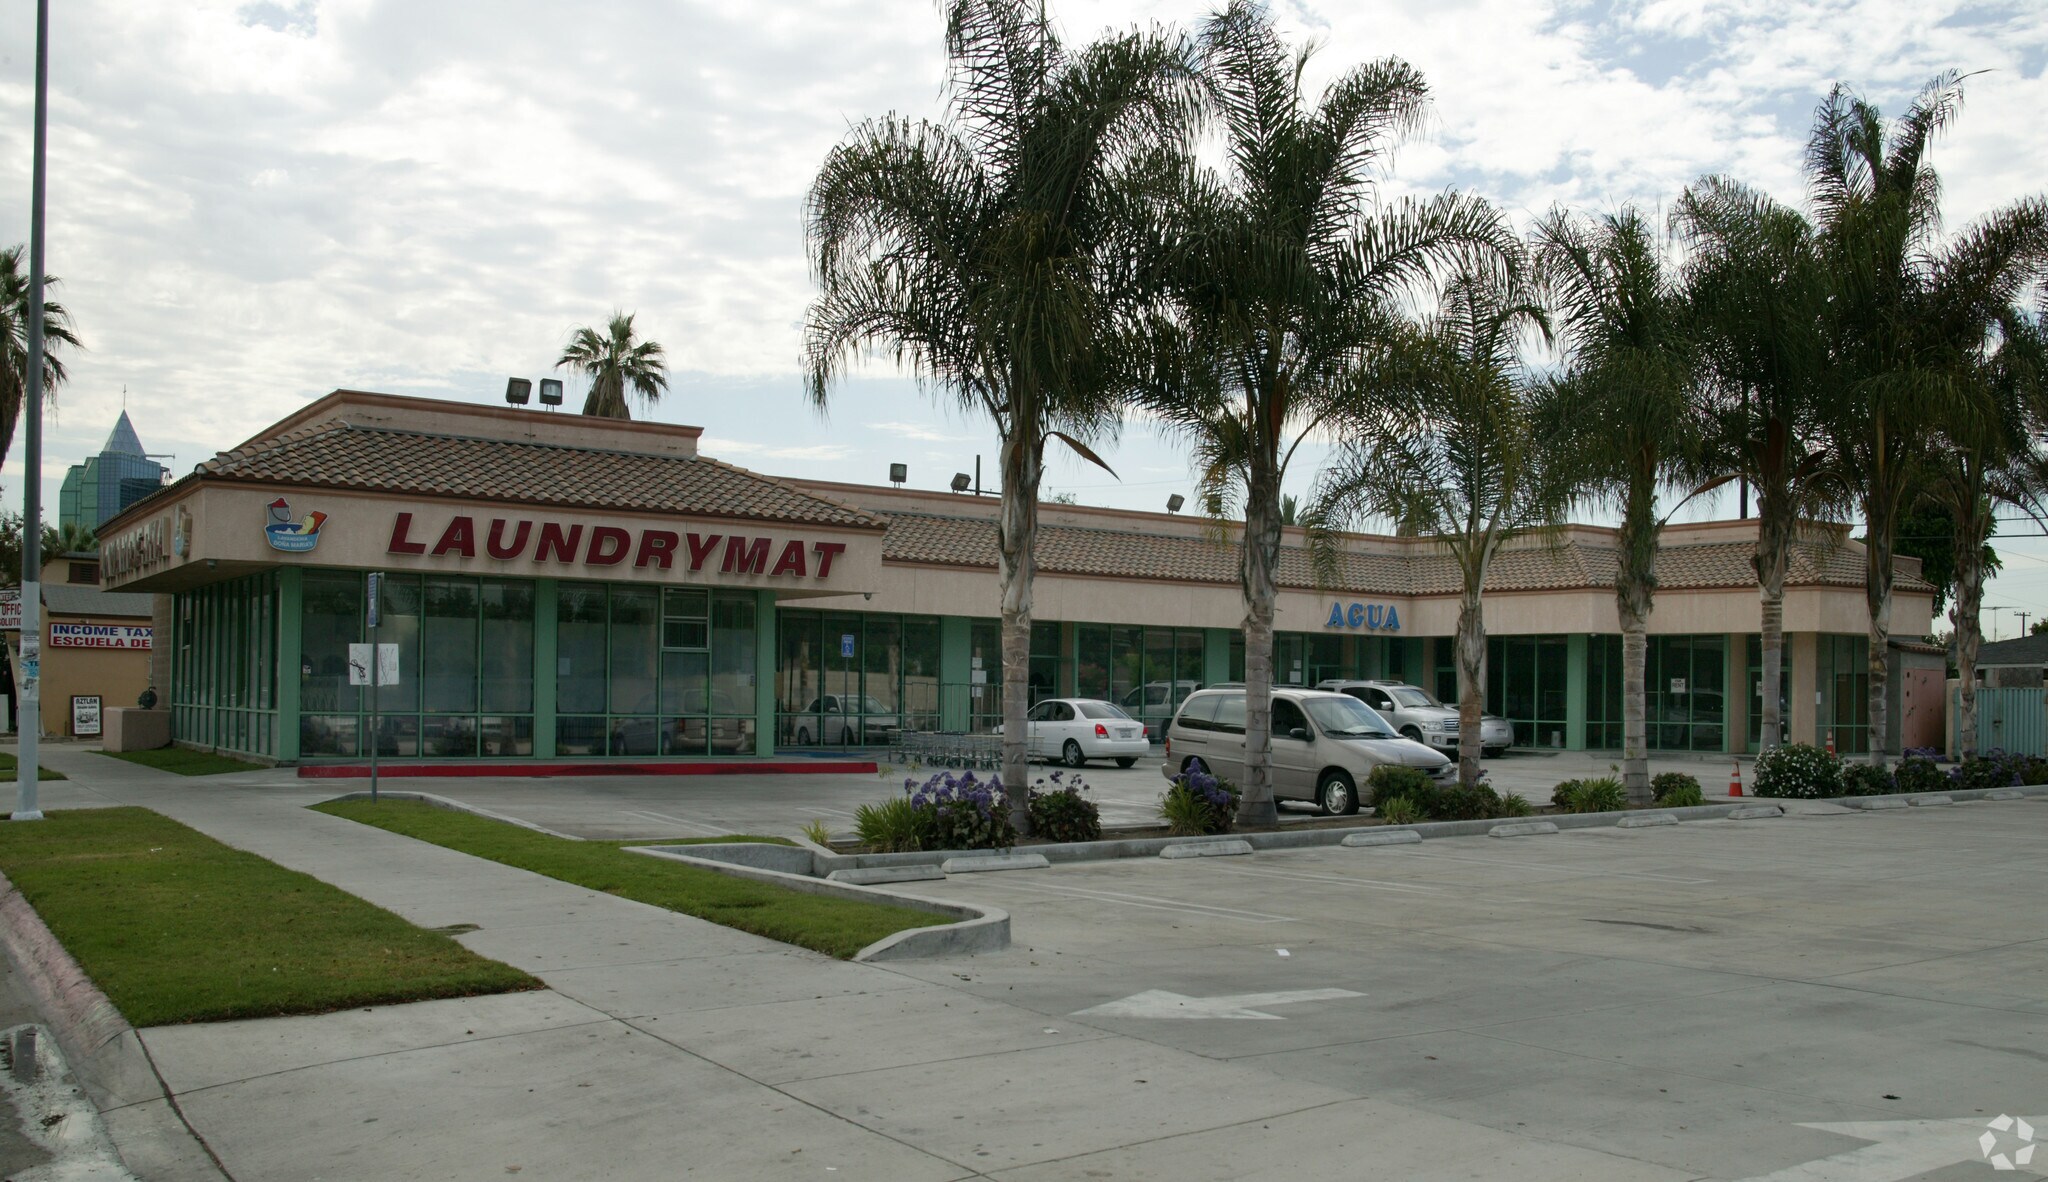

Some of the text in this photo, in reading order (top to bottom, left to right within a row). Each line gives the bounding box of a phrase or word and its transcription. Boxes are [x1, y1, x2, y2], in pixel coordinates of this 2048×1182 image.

[386, 512, 847, 579] LAUNDRYMAT
[2, 603, 21, 616] OFFIC
[1324, 602, 1401, 631] AGUA
[53, 625, 153, 637] INCOME TAX
[53, 636, 151, 648] ESCUELA DE
